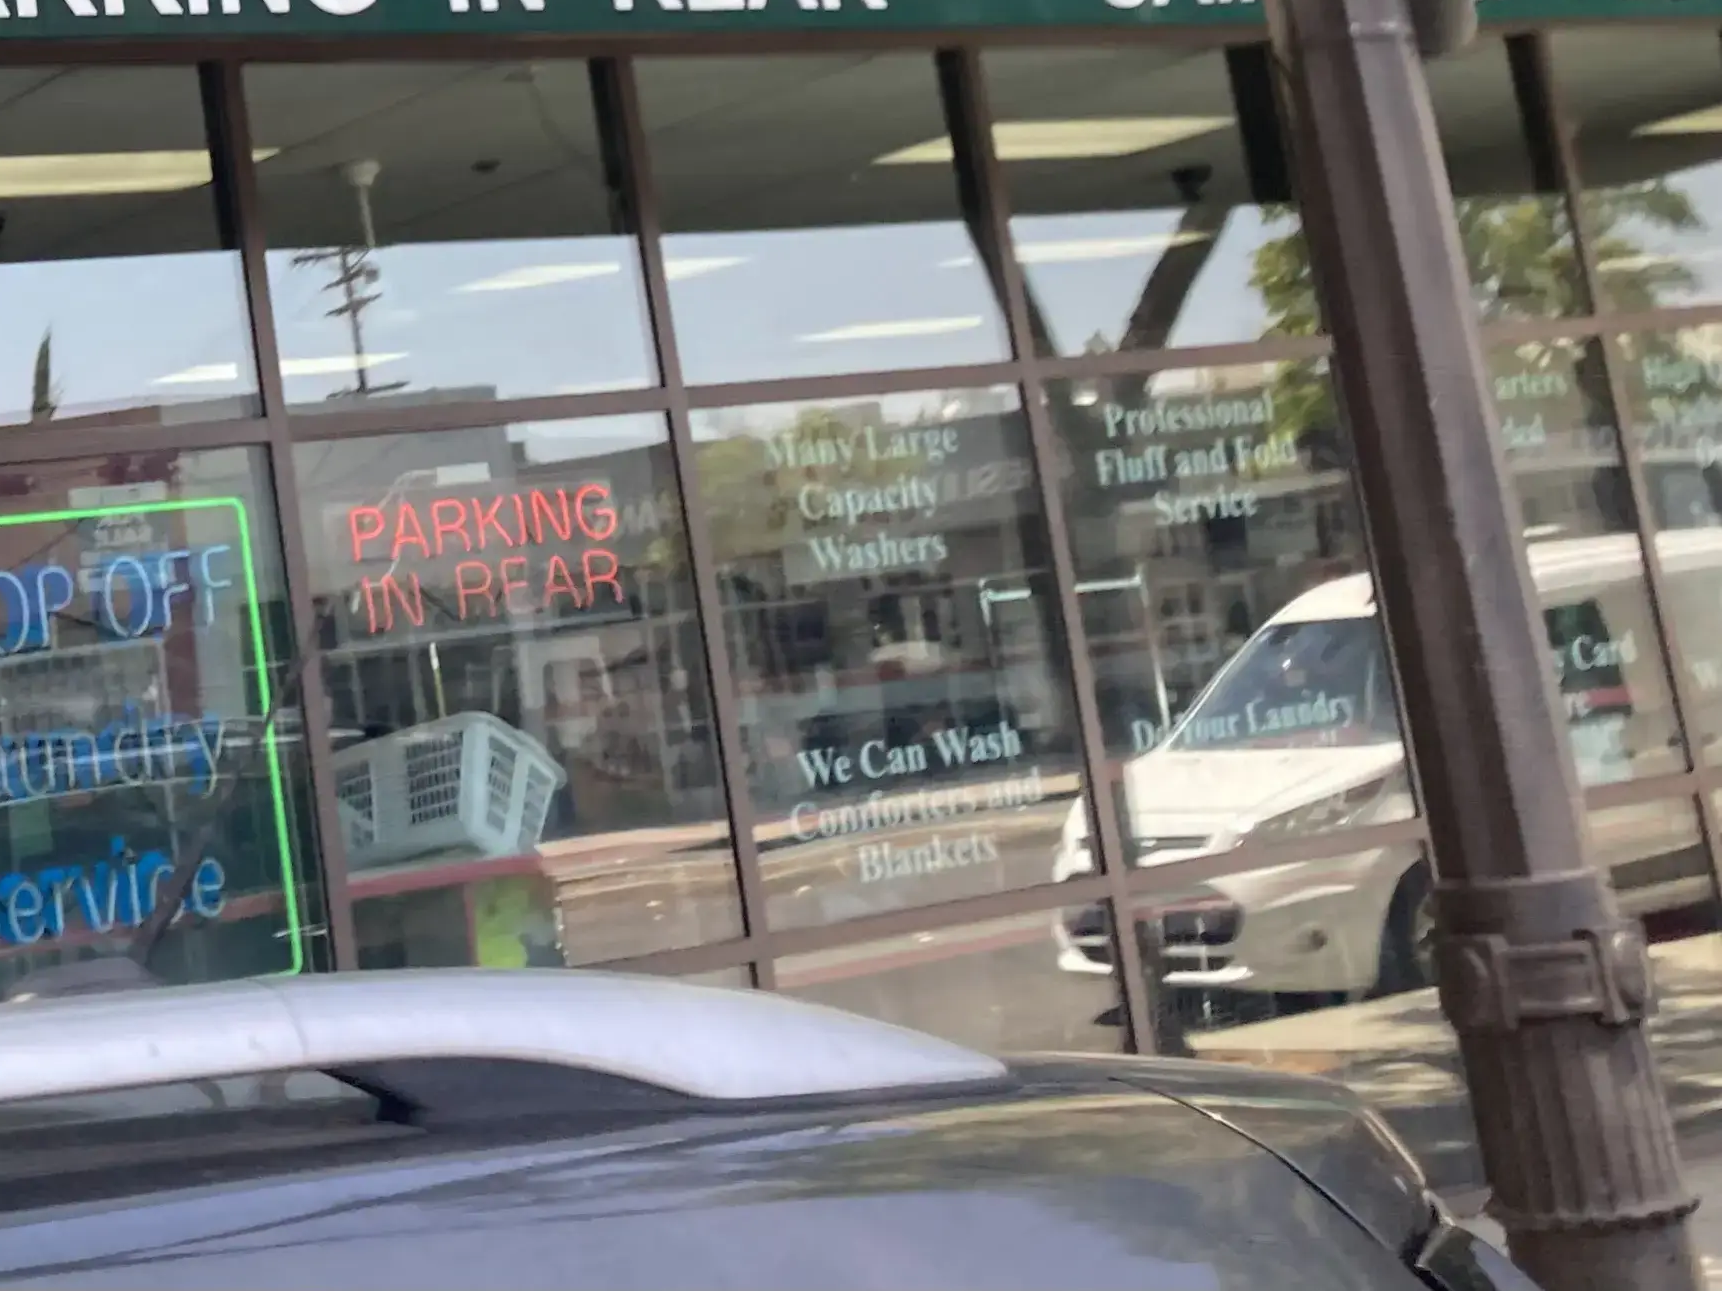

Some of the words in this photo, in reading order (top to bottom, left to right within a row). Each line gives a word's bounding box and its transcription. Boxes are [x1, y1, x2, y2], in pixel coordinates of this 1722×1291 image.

[1103, 389, 1274, 438] Professional
[763, 429, 858, 472] Many
[863, 424, 960, 466] Large
[1094, 445, 1168, 489] Fluff
[1174, 438, 1230, 478] and
[1233, 430, 1298, 472] Fold
[348, 482, 620, 563] PARKING
[797, 472, 939, 526] Capacity
[1154, 485, 1261, 527] Service
[808, 530, 949, 571] Washers
[103, 544, 232, 639] OFF
[361, 570, 425, 634] IN
[796, 745, 854, 789] We
[859, 739, 929, 780] Can
[931, 720, 1023, 768] Wash
[985, 764, 1044, 808] and
[858, 831, 1000, 883] Blankets
